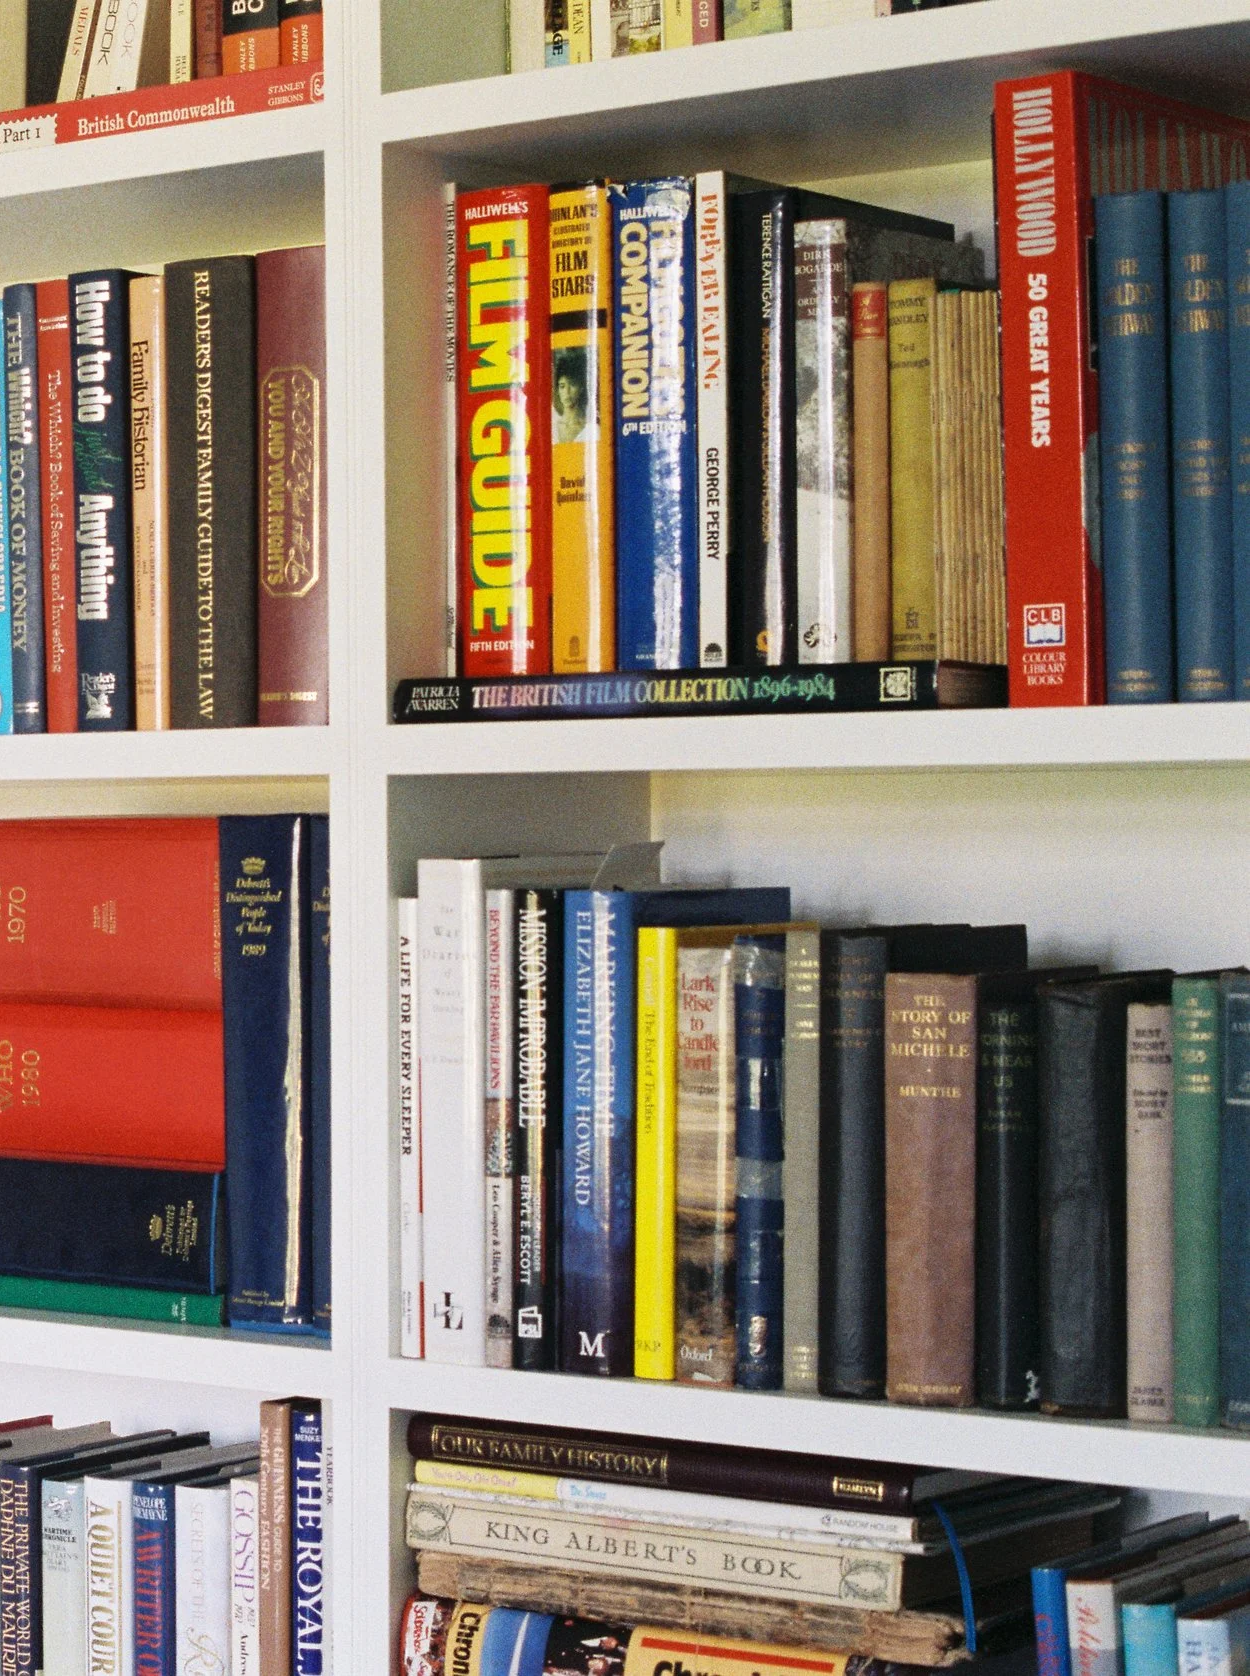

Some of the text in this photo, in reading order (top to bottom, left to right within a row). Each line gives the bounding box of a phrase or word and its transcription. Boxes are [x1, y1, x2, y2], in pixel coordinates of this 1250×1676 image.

[267, 92, 304, 107] GIBBONS
[268, 81, 306, 95] STANLEY
[3, 127, 29, 145] Part
[78, 112, 125, 137] British
[127, 96, 236, 128] Commonwealth
[465, 201, 528, 221] HALLIWELL'S
[552, 273, 594, 298] STARS
[556, 249, 588, 272] FILM
[1012, 87, 1057, 448] HOLLYWOOD 50 GREAT YEARS
[700, 194, 721, 390] FOREVER EALING
[619, 221, 648, 418] COMPANION
[75, 280, 114, 619] How to do Anything
[467, 219, 534, 636] FILM GUIDE
[194, 270, 214, 720] READER'S DIGEST FAMILY GUIDE TO THE LAW
[267, 381, 286, 585] YOU AND YOUR RIGHTS
[706, 447, 720, 560] GEORGE PERRY
[1026, 609, 1062, 623] CLB
[1023, 651, 1067, 664] COLOUR
[1023, 663, 1067, 675] LIBRARY
[1026, 673, 1064, 686] BOOKS
[472, 676, 836, 708] THE BRITISH FILM COLLECTION 1896-1984
[7, 886, 26, 944] 1970
[400, 936, 412, 1156] A LIFE FOR EVERY SLEEPER
[573, 911, 592, 1205] ELIZABETH JANE HOWARD
[891, 1042, 970, 1058] MICHELE
[912, 1026, 947, 1039] SAN
[21, 1049, 40, 1107] 1980
[899, 1086, 961, 1098] MUNTHE
[441, 1434, 658, 1475] OUR FAMILY HISTORY
[14, 1480, 31, 1666] THE PRIVATE WORLD
[297, 1452, 323, 1661] THE ROYAL
[485, 1519, 802, 1580] KING ALBERT'S BOOK
